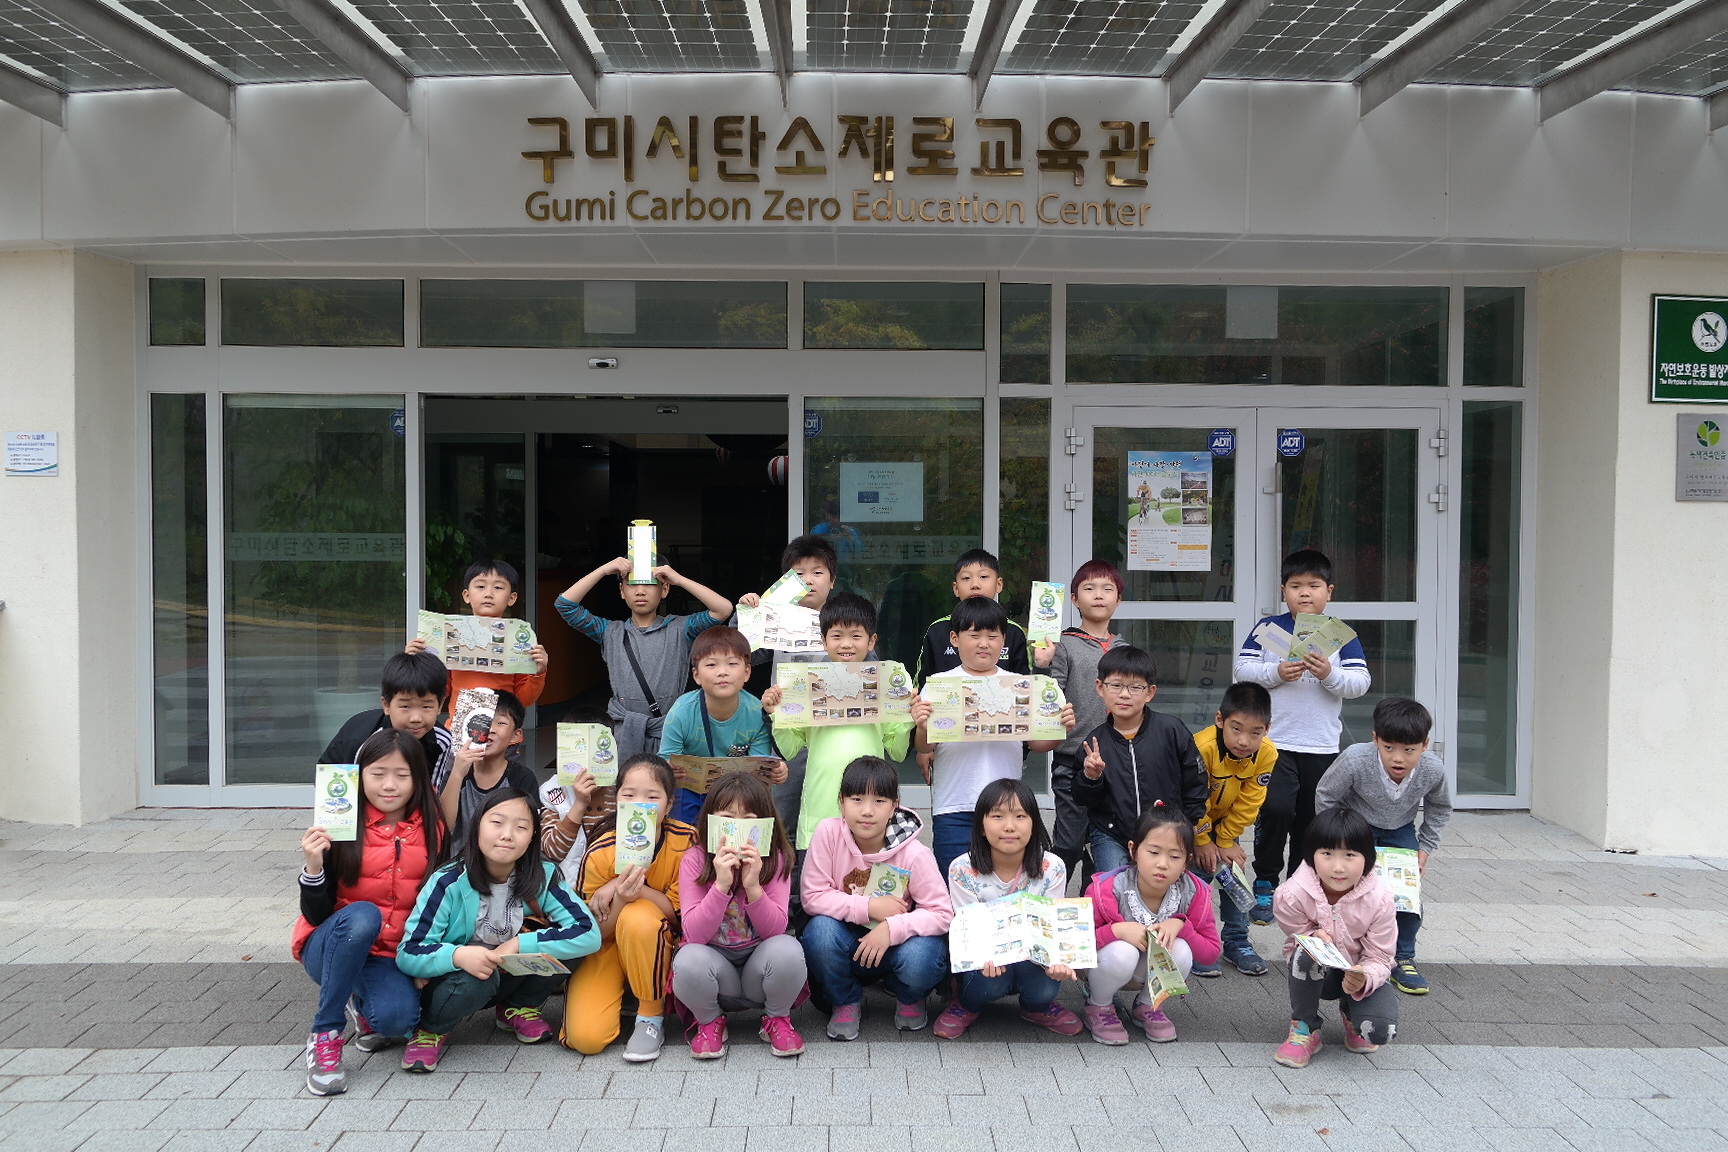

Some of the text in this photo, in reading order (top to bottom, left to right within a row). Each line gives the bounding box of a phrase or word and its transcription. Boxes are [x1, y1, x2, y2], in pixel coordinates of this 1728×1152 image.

[521, 115, 1156, 188] 구미시탄소제로교육관
[525, 189, 1152, 226] Gumi Carbon Zero Education Center
[1660, 362, 1708, 378] 자연보호운동
[1211, 437, 1231, 447] ADT
[1281, 437, 1301, 448] ADT
